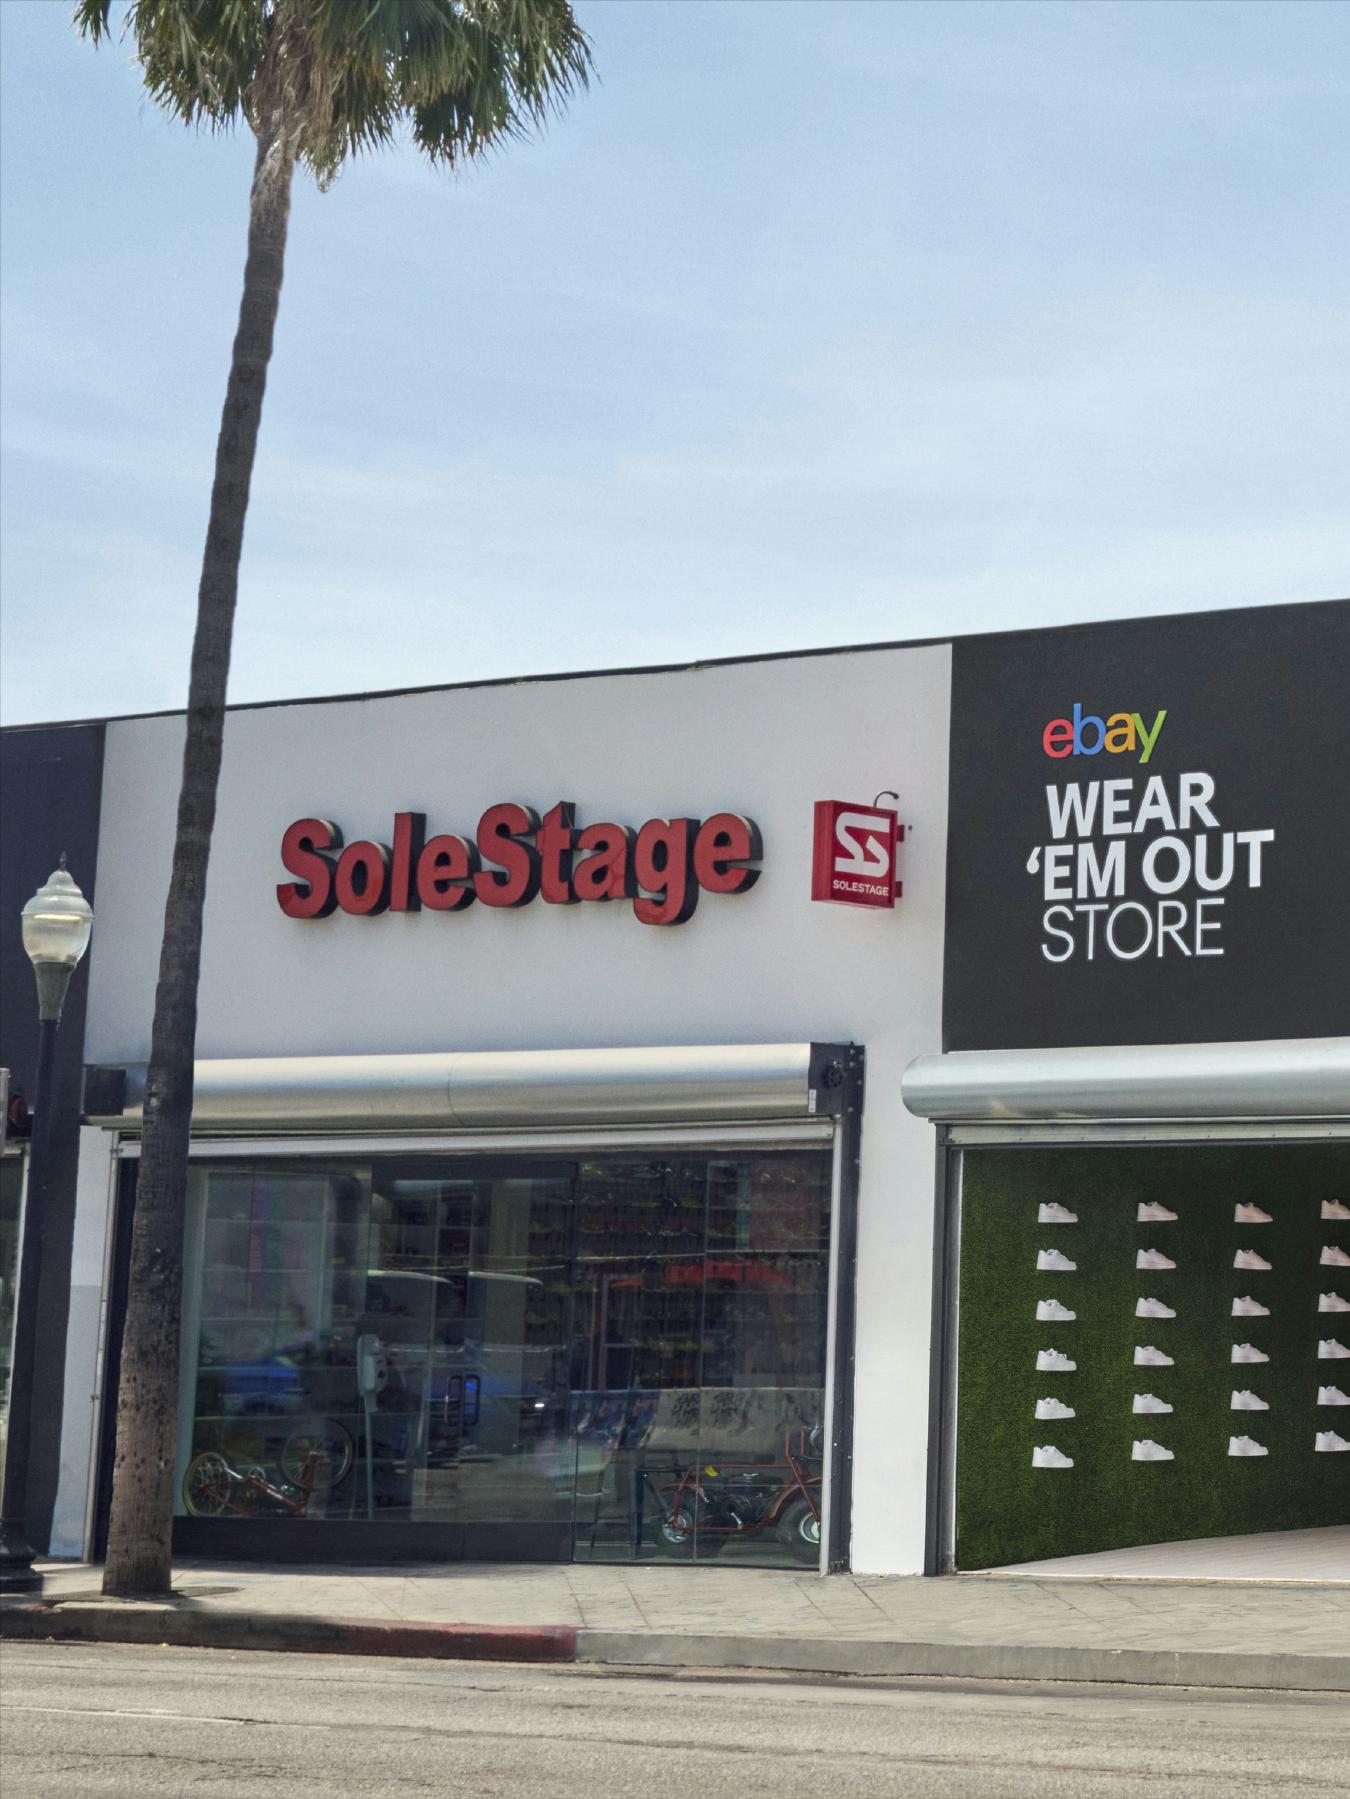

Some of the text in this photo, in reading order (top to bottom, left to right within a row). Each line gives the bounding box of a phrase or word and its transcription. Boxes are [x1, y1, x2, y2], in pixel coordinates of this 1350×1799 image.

[1043, 702, 1168, 764] ebay
[1046, 772, 1220, 839] WEAR
[276, 801, 764, 926] SoleStage
[832, 879, 890, 897] SOLESTAGE
[1142, 829, 1275, 894] OUT
[1041, 897, 1225, 962] STORE
